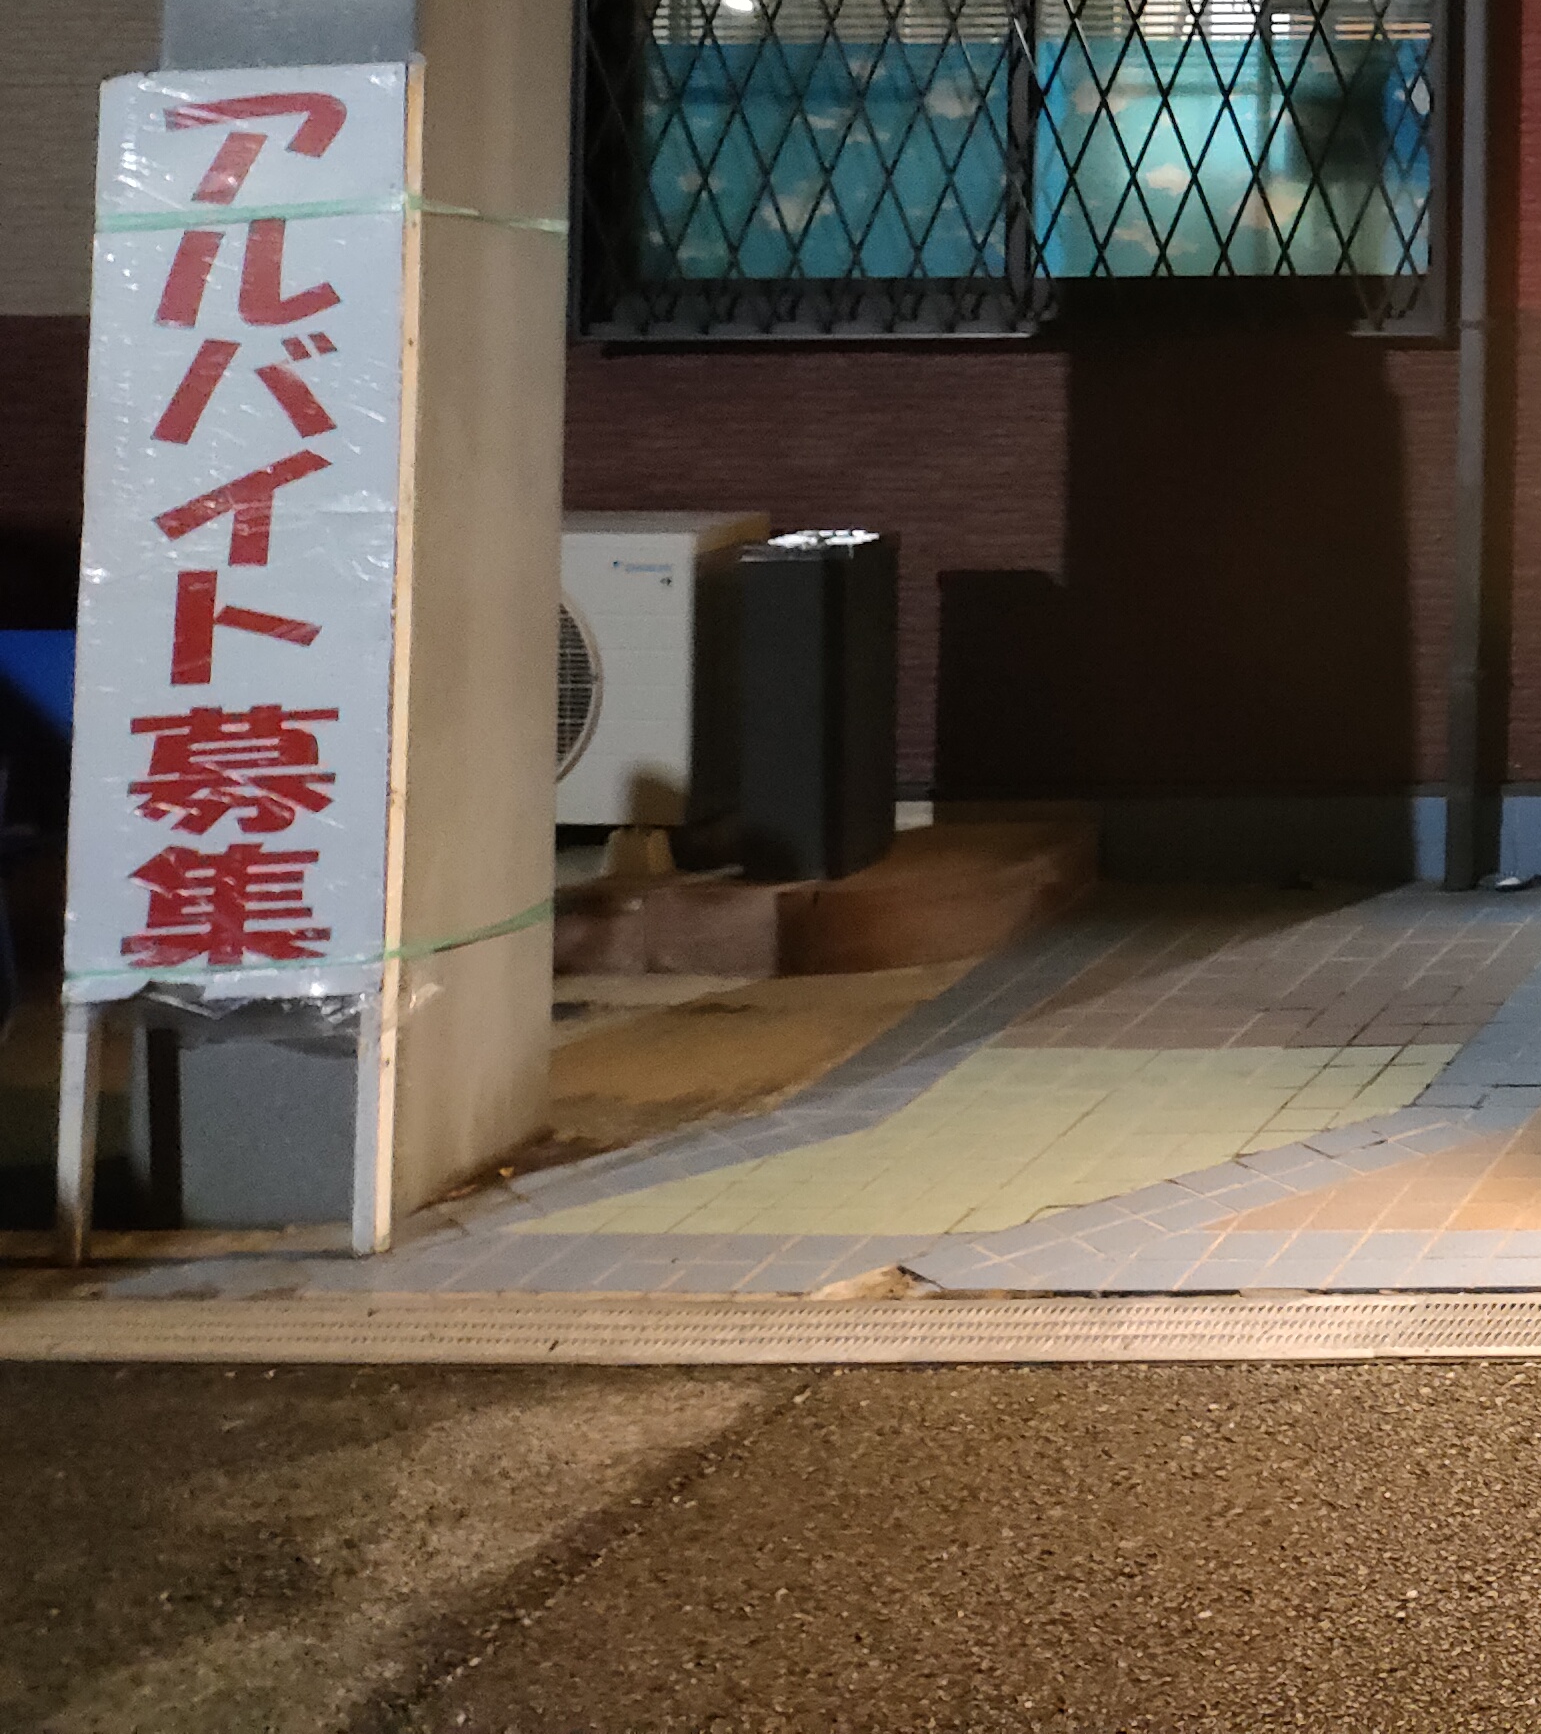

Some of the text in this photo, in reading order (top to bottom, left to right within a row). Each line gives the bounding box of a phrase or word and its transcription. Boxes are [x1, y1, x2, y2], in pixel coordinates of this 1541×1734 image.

[119, 91, 349, 969] アルバイト募集
